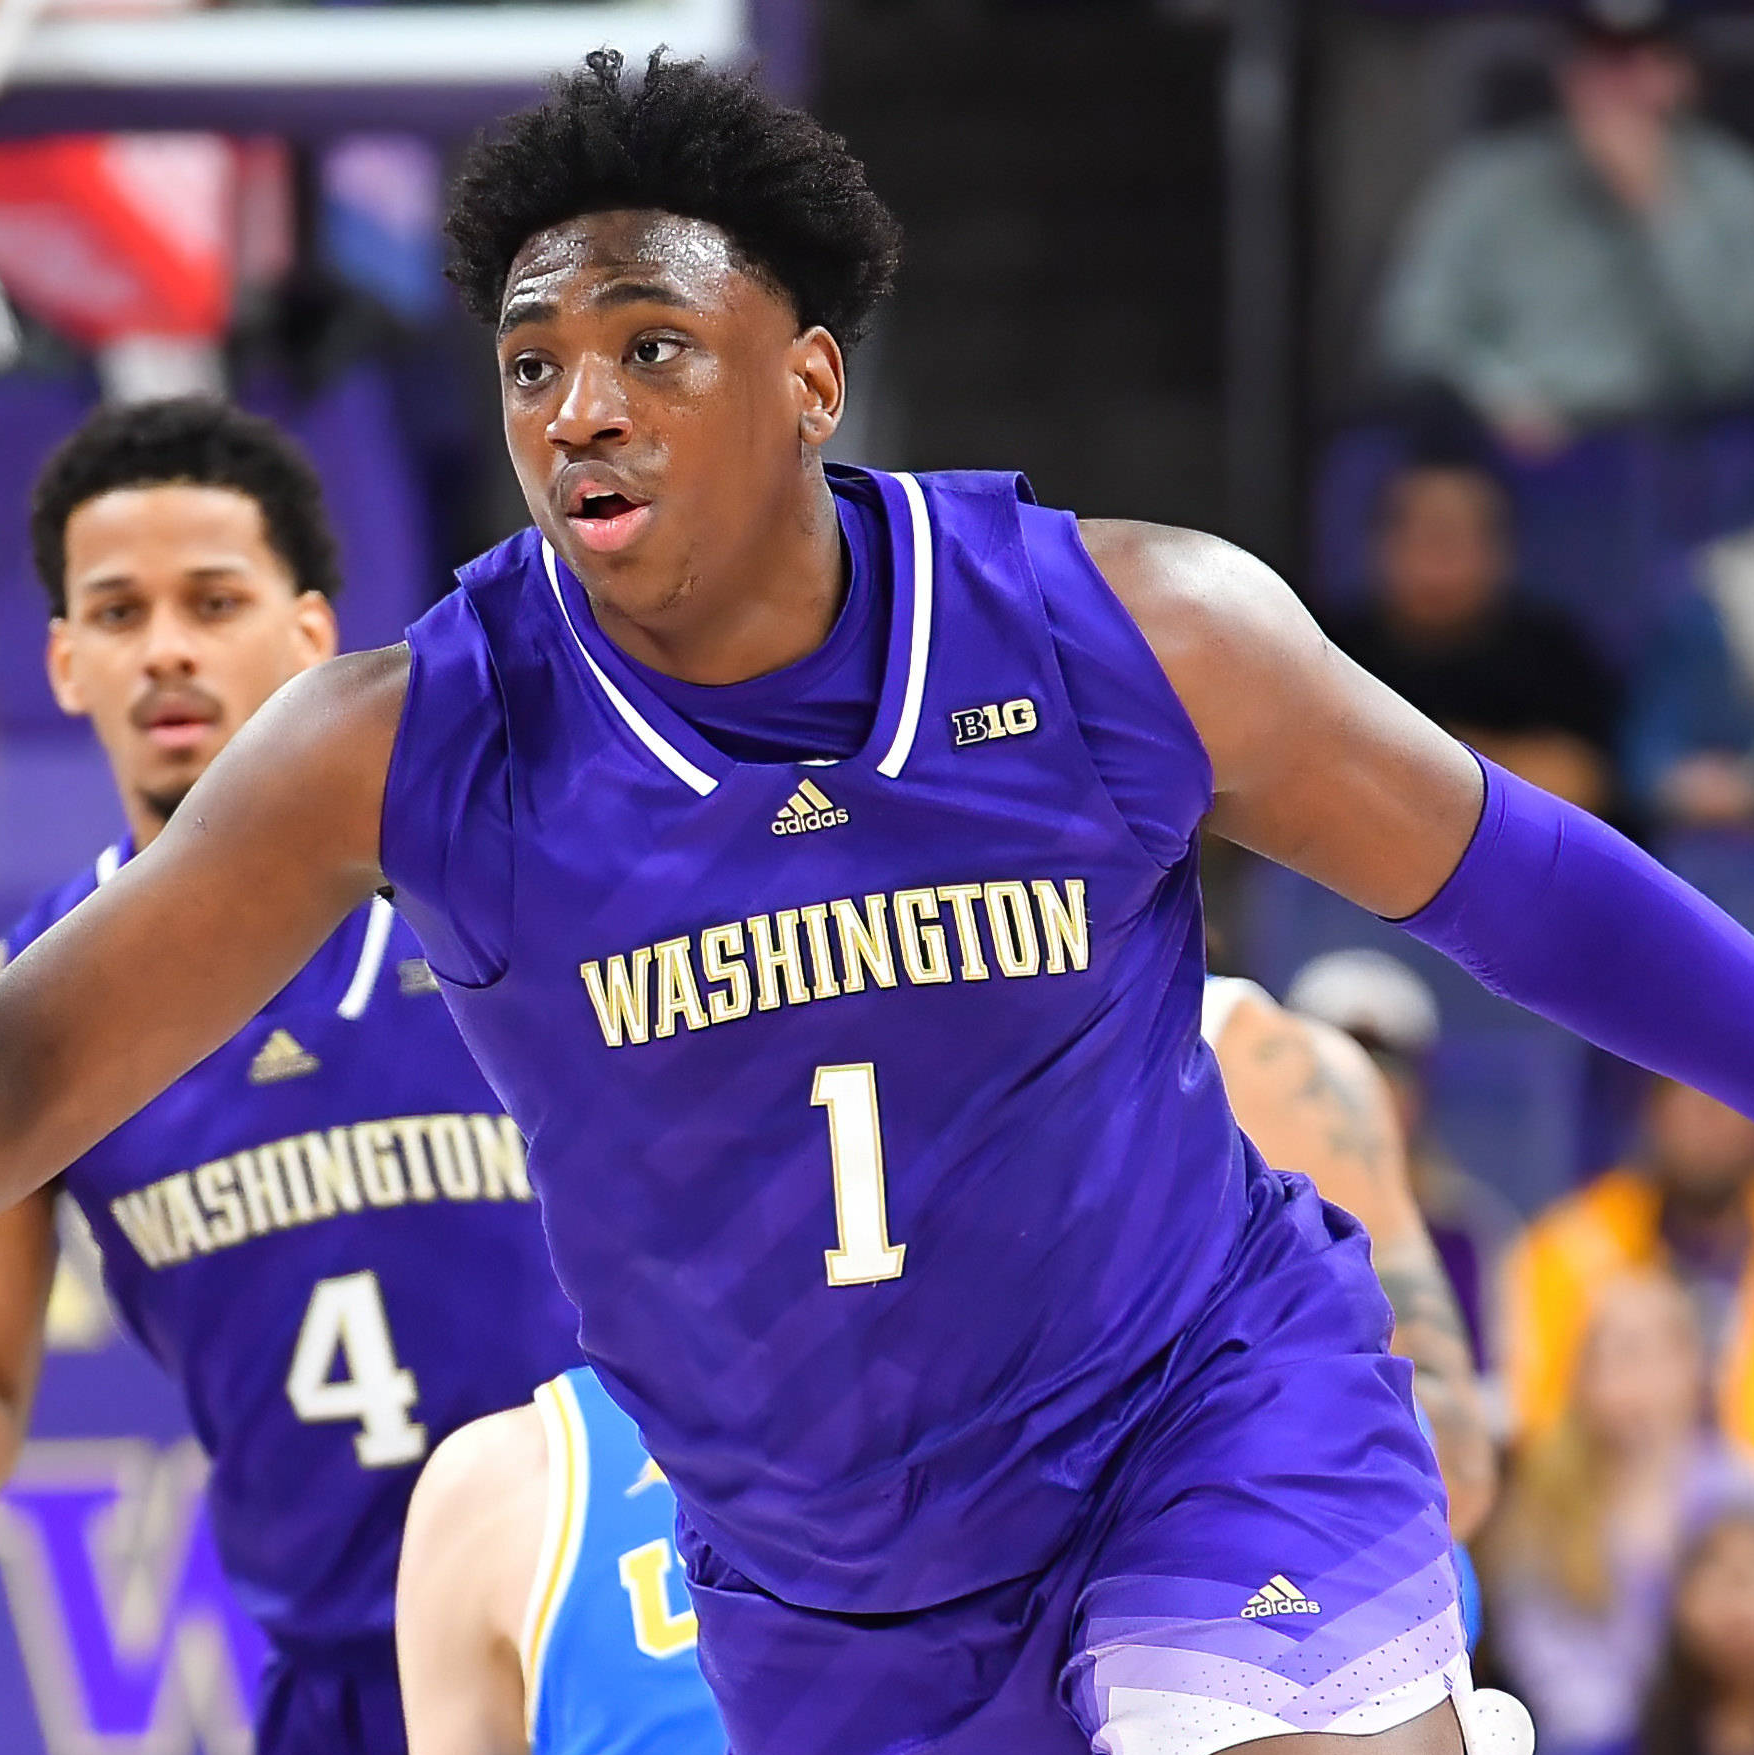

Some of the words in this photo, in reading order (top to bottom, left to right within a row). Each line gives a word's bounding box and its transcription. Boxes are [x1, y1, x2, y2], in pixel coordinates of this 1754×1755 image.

[771, 808, 849, 835] adidas
[580, 879, 1091, 1047] WASHINGTON
[108, 1112, 537, 1271] WASHINGTON
[810, 1062, 907, 1287] 1
[286, 1269, 428, 1468] 4
[1240, 1598, 1322, 1619] adidas
